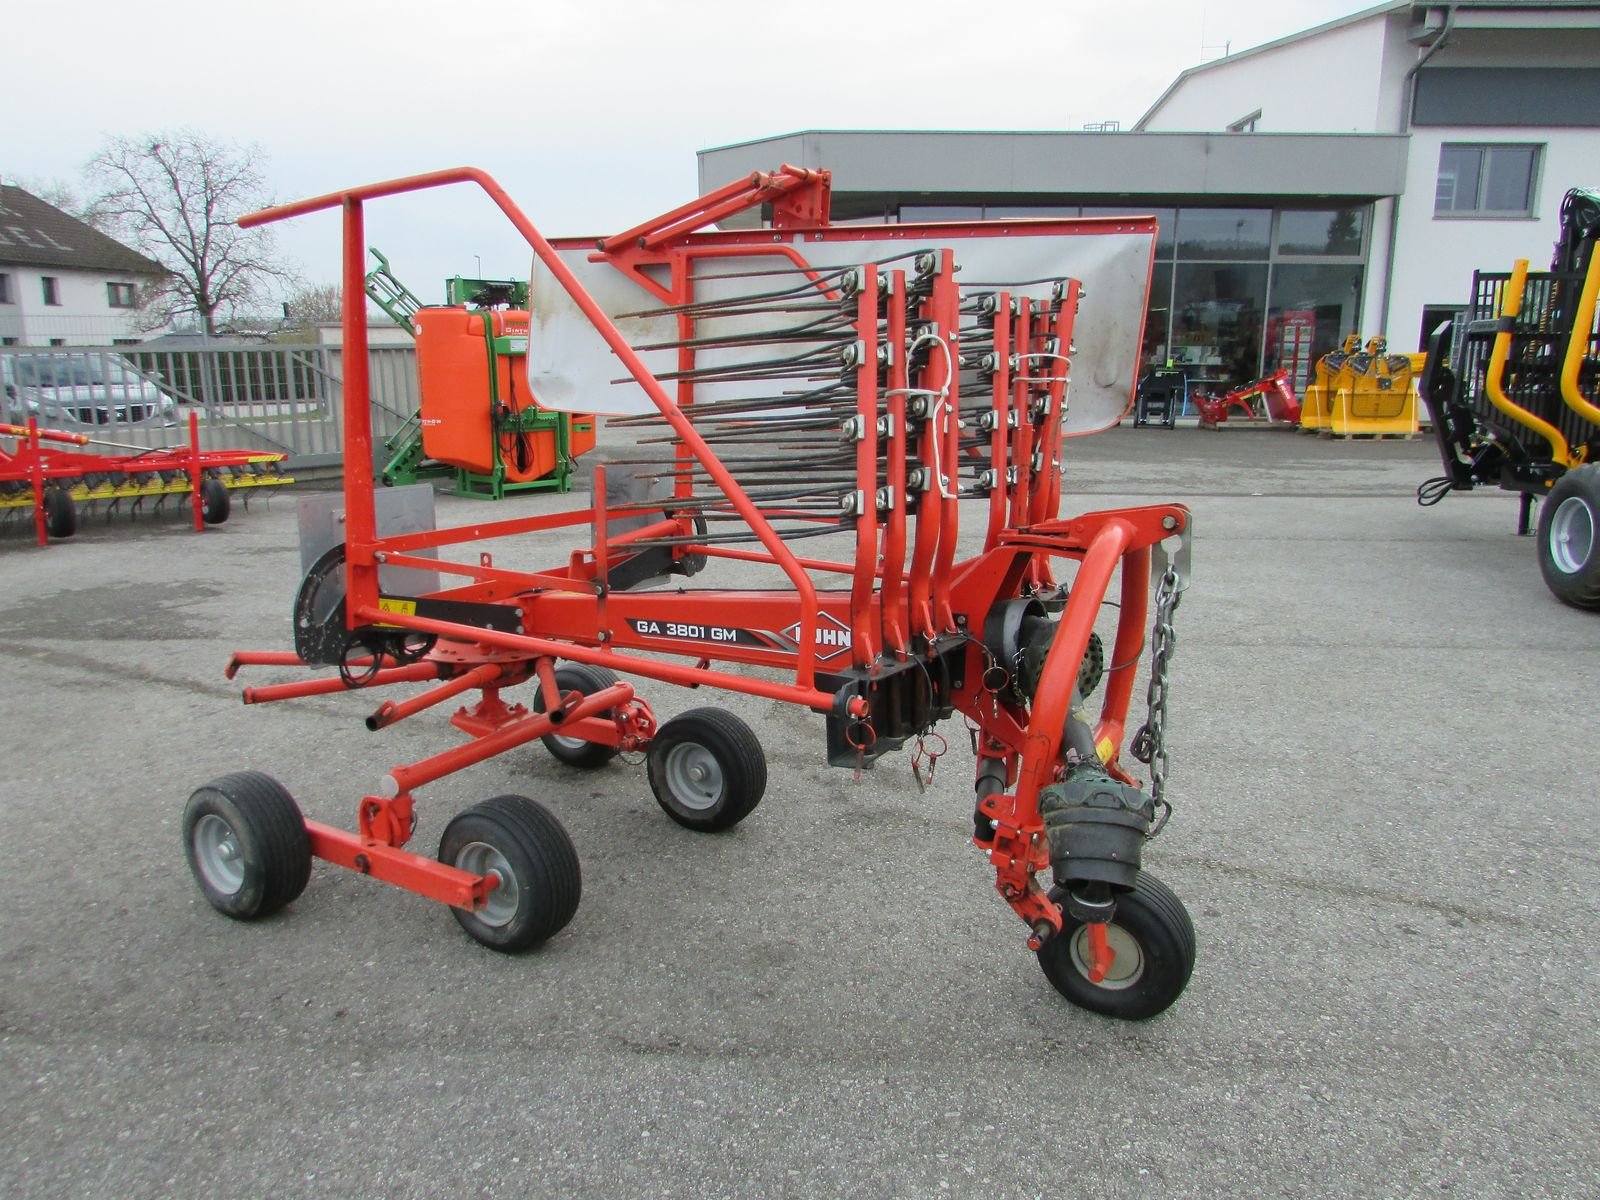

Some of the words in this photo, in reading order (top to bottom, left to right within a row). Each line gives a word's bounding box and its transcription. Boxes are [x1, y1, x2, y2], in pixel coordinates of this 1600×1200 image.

[636, 620, 661, 634] GA
[666, 623, 705, 639] 3801
[711, 627, 737, 642] GM
